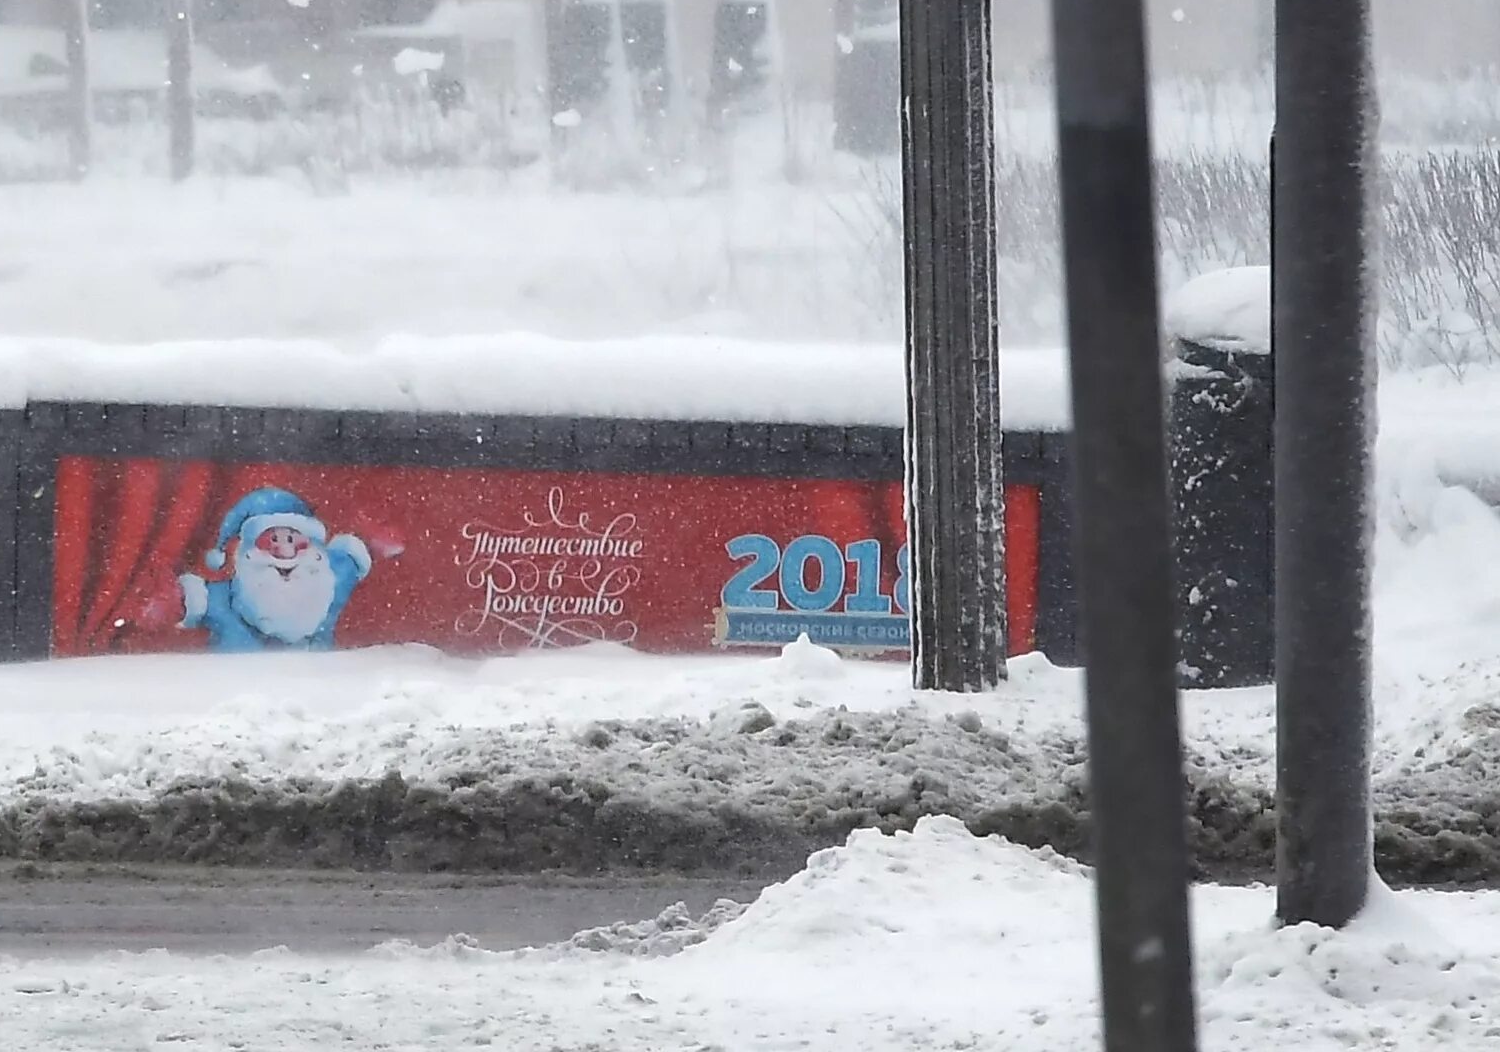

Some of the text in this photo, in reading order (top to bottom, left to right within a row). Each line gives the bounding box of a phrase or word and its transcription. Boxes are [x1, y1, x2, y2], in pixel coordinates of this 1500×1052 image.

[463, 510, 644, 566] Путешествие
[467, 562, 640, 632] Рождество
[720, 533, 910, 615] 201
